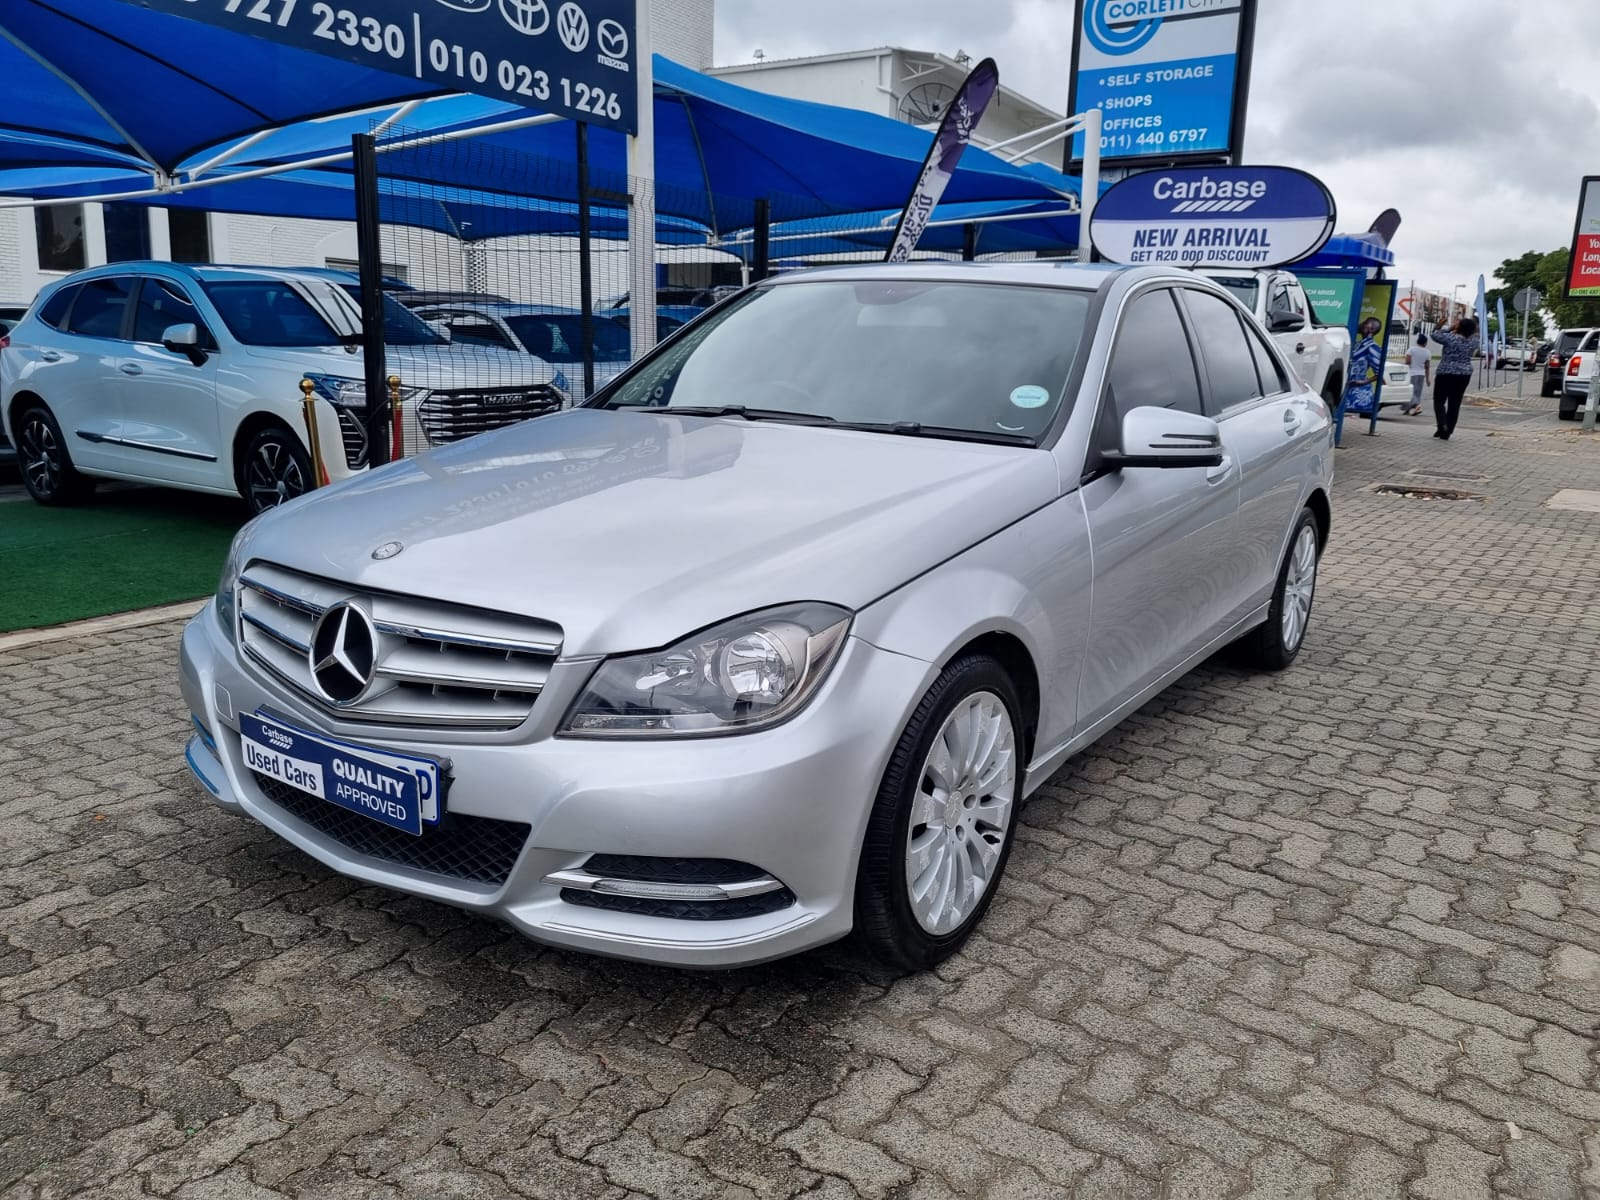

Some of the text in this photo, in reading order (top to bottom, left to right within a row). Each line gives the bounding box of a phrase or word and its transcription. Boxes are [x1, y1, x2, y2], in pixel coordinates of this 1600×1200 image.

[312, 8, 405, 59] 2330
[429, 38, 488, 83] 010
[498, 60, 550, 101] 023
[560, 78, 622, 121] 1226
[597, 54, 629, 72] mazda
[1106, 65, 1214, 87] SELF STORAGE
[1105, 95, 1153, 110] SHOPS
[1103, 115, 1162, 130] OFFICES
[1136, 131, 1164, 145] 440
[1169, 128, 1208, 144] 6797
[1153, 176, 1267, 200] Carbase
[1133, 228, 1271, 248] NEW ARRIVAL
[1130, 250, 1269, 262] GET R20 000 DISCOUNT
[261, 725, 294, 746] Carbase
[246, 743, 317, 791] Used Cars
[332, 758, 405, 798] QUALITY
[336, 782, 407, 821] APPROVED
